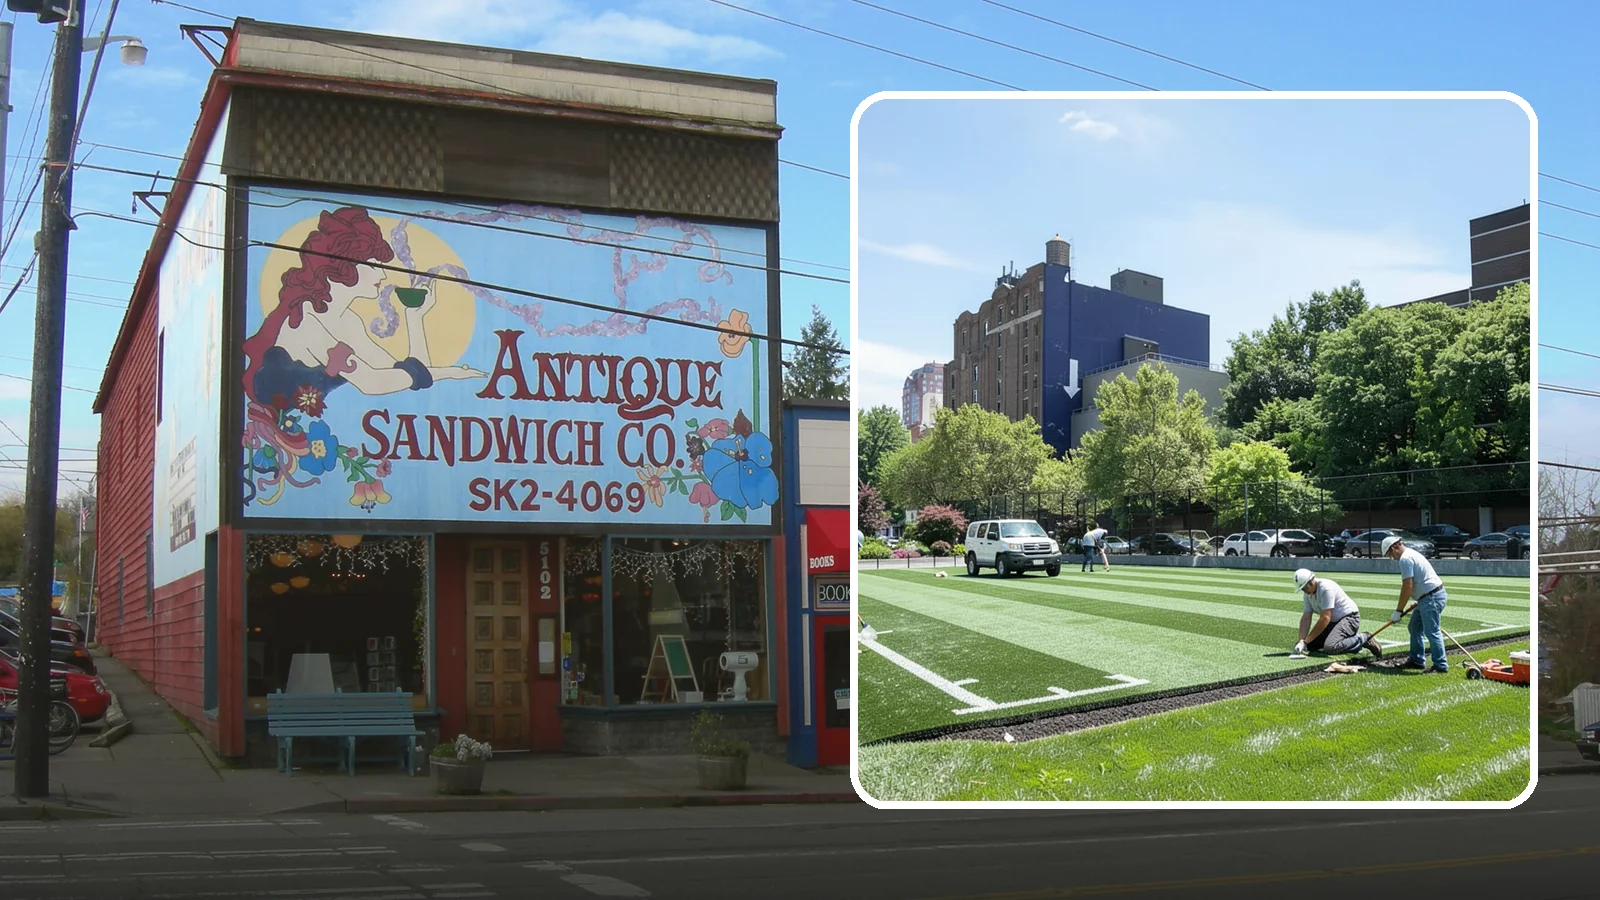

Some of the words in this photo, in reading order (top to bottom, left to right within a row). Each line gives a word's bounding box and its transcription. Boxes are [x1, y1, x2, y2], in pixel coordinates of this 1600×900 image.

[476, 329, 724, 420] ANTIQUE
[361, 409, 604, 467] SANDWICH
[617, 422, 684, 469] CO.
[468, 476, 646, 513] SK2-4069
[540, 541, 551, 600] 5102
[809, 555, 835, 569] BOOKS
